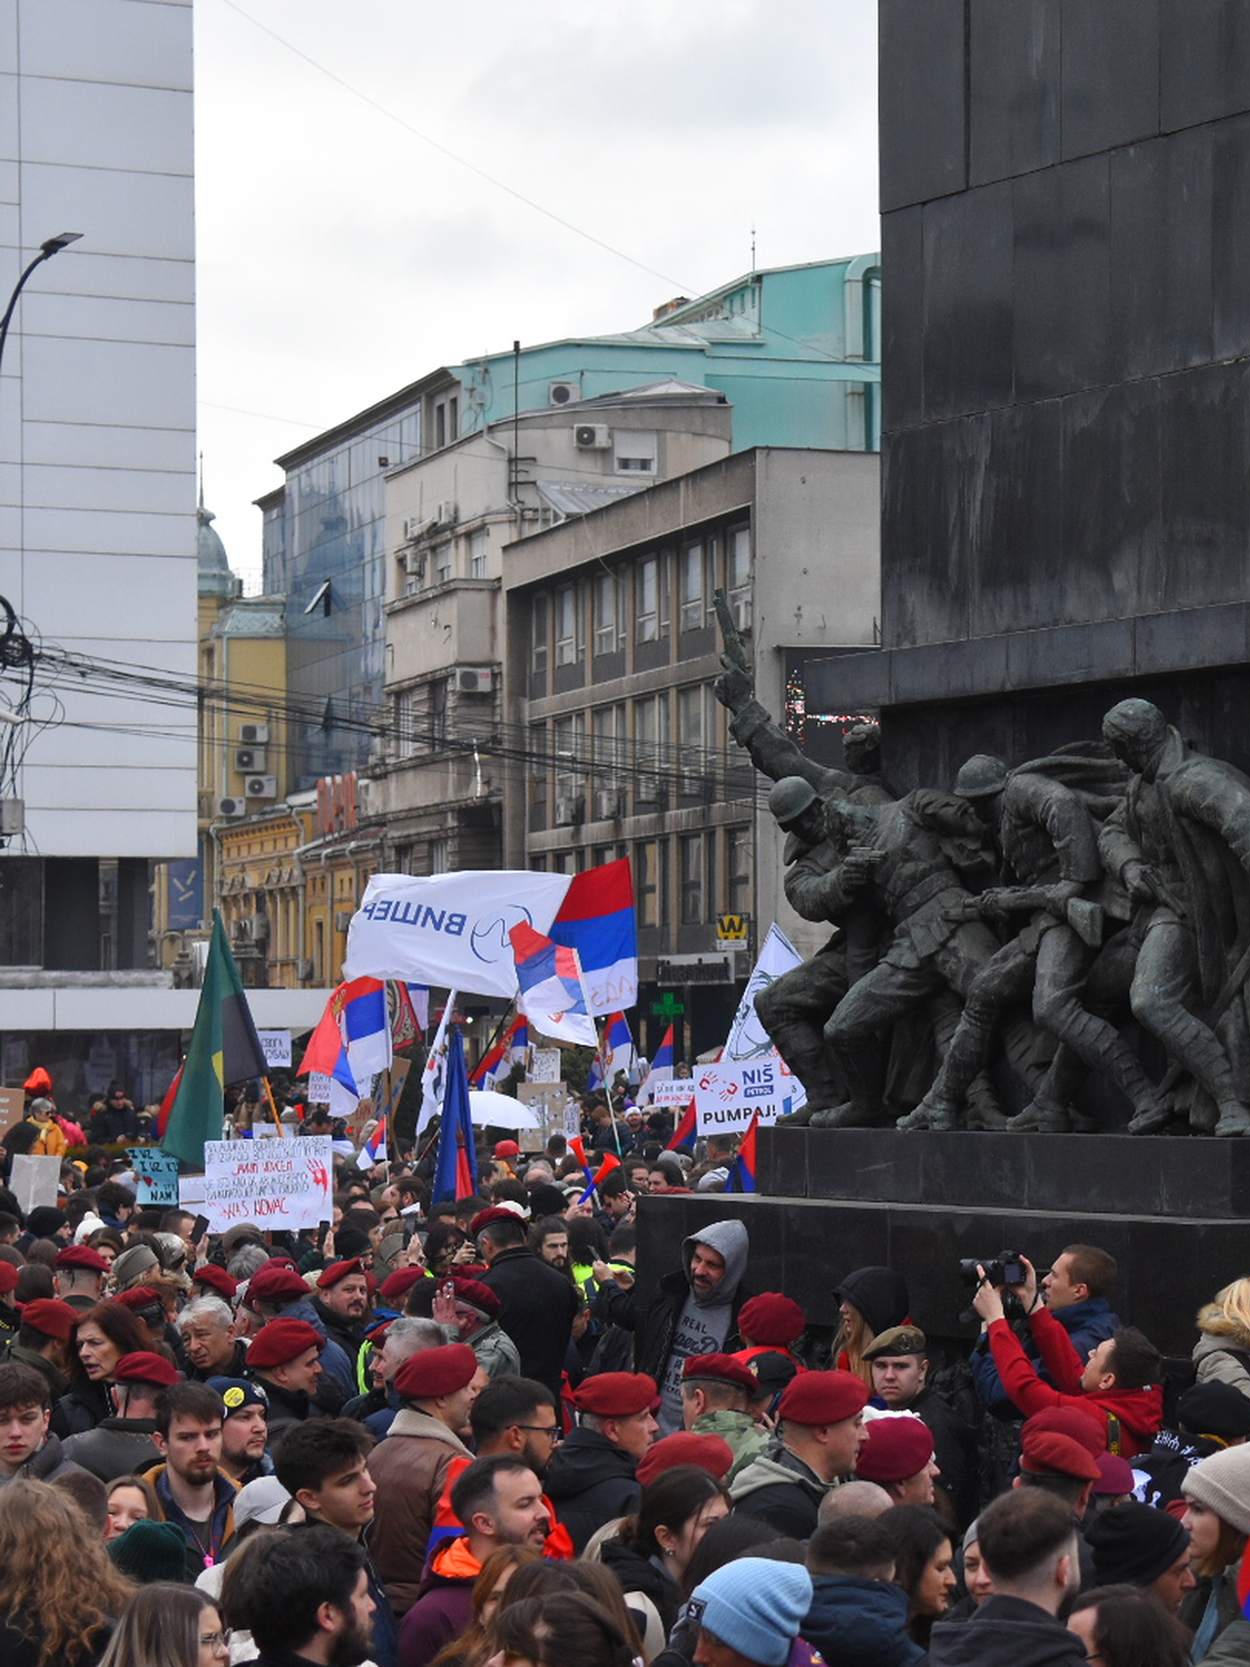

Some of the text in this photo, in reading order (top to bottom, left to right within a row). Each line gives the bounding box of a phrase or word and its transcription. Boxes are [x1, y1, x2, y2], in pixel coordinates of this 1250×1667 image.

[742, 1064, 774, 1085] NIŠ
[703, 1105, 777, 1125] PUMPAJ!
[682, 1315, 707, 1334] REAL
